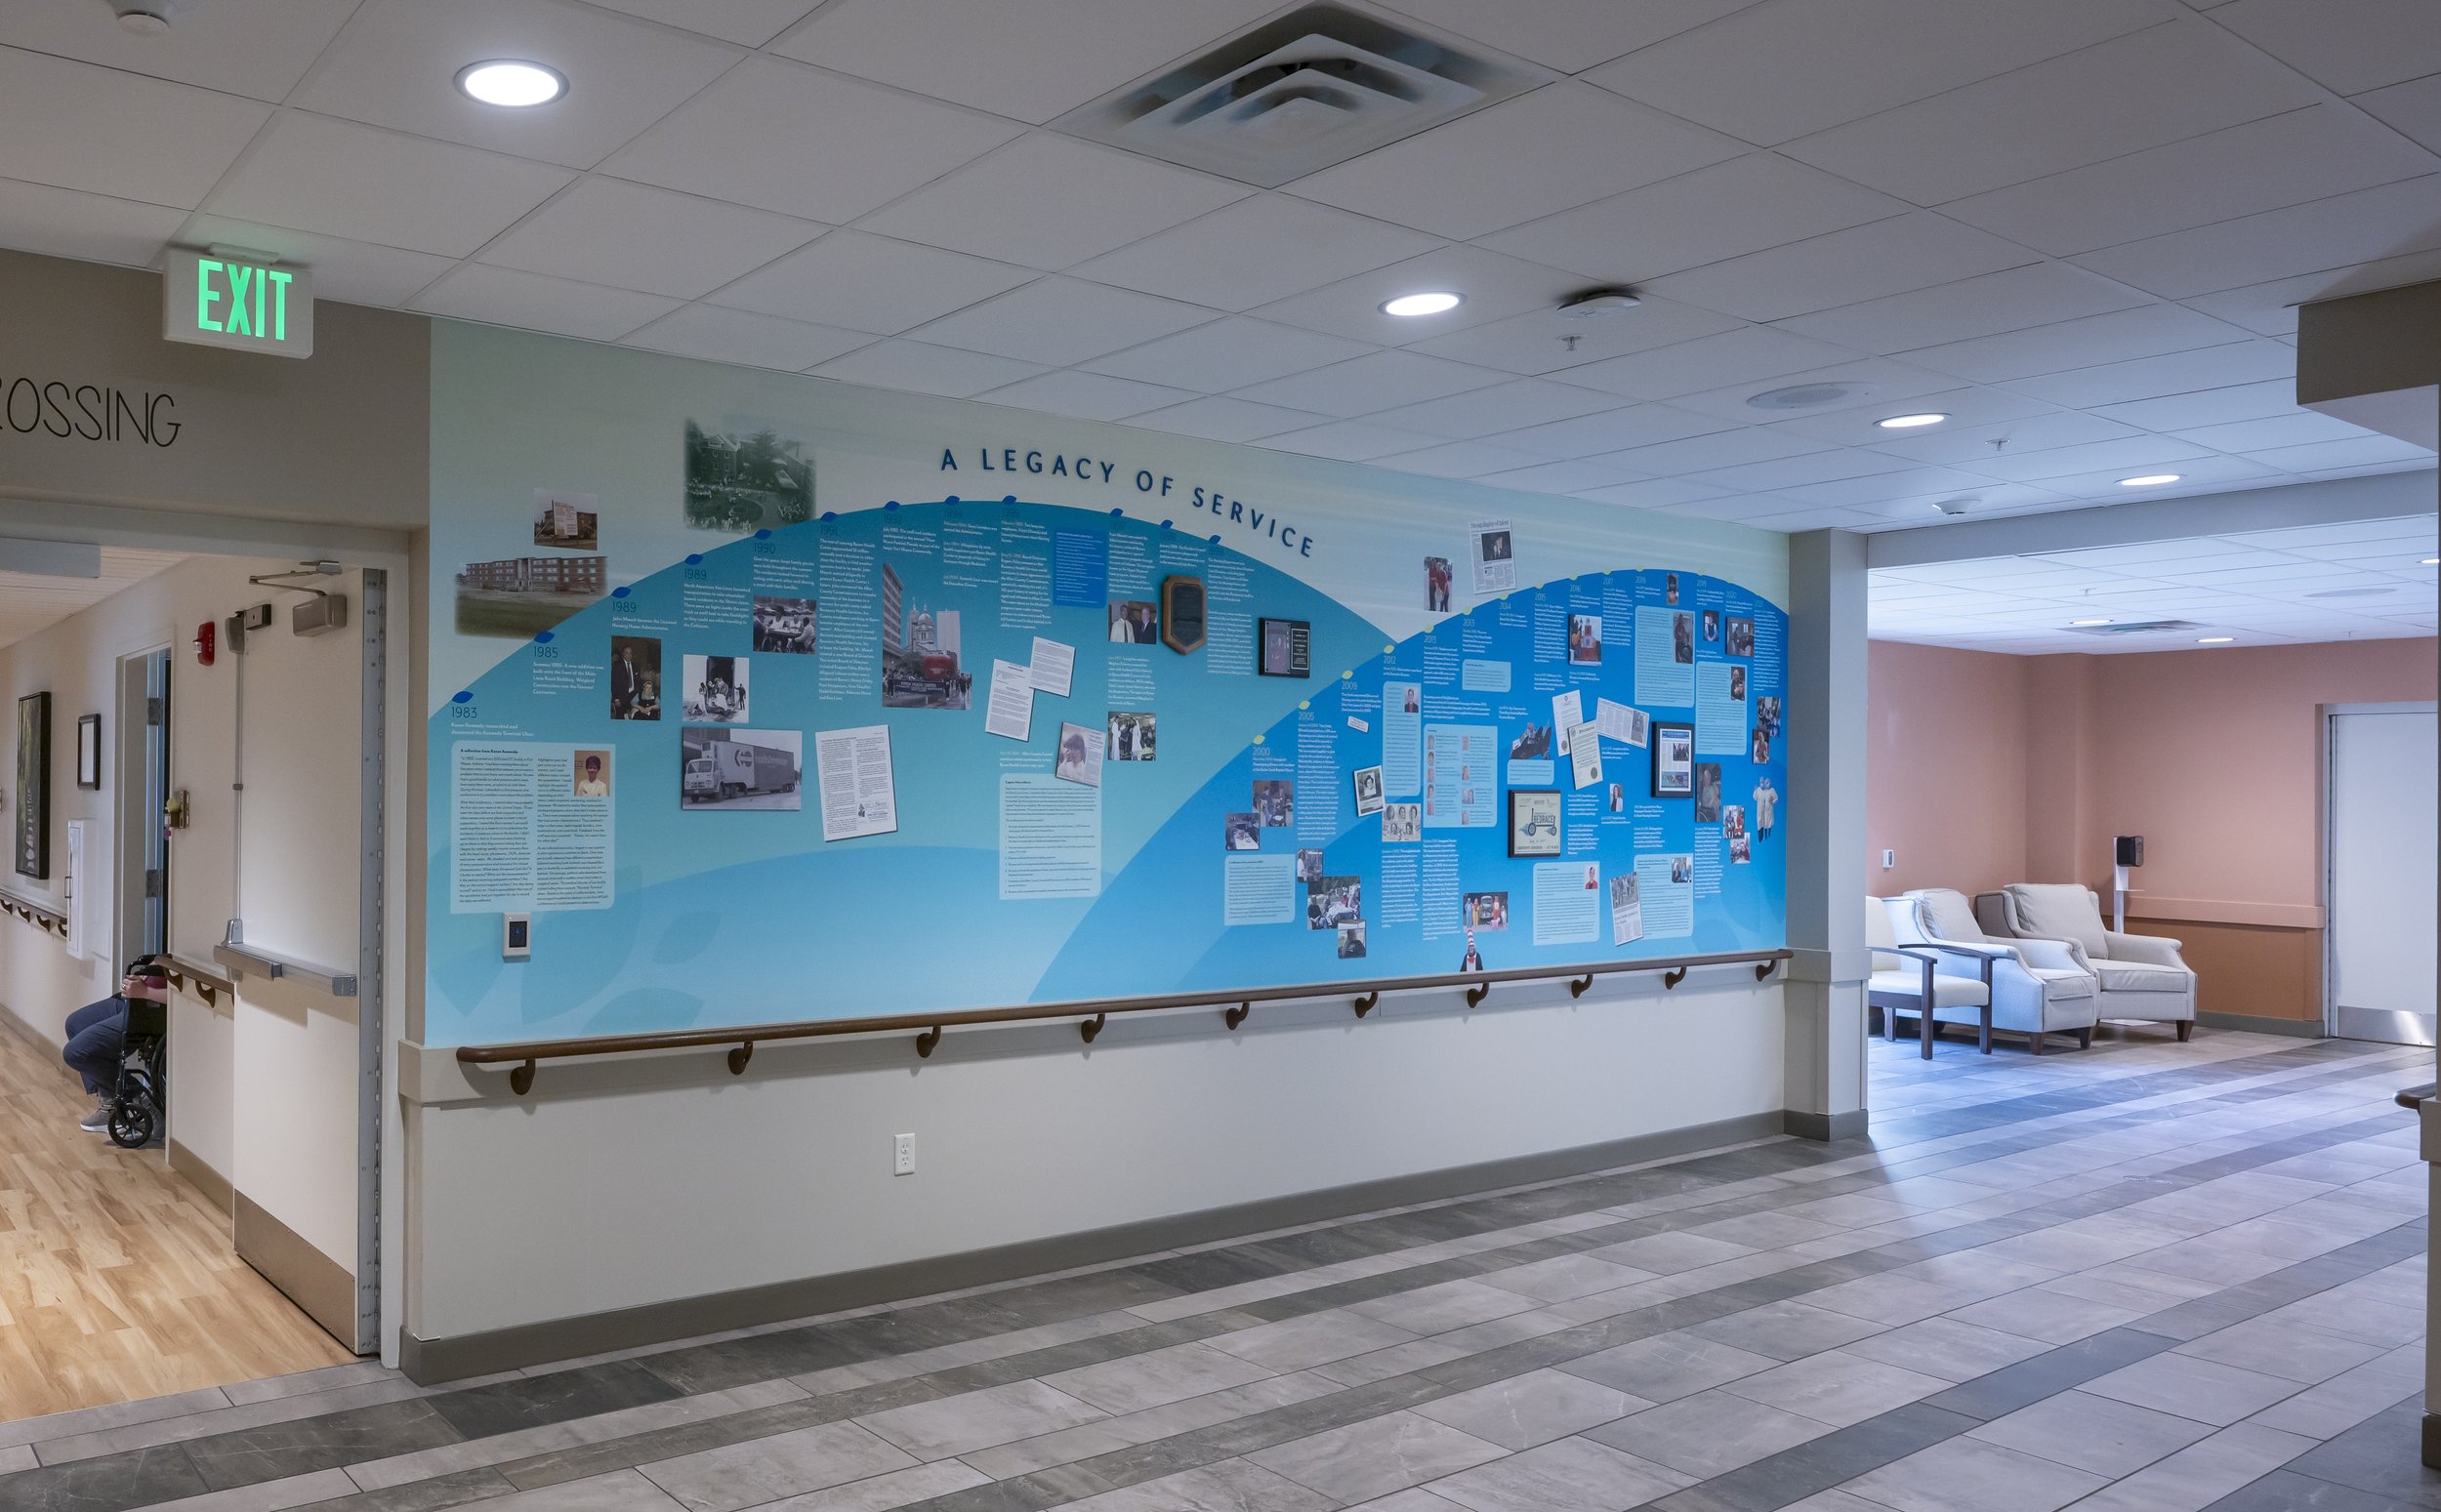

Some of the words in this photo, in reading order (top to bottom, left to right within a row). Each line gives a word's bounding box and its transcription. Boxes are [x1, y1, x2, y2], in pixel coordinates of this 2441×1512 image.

[198, 258, 293, 341] EXIT
[0, 377, 182, 447] OSSING
[941, 448, 958, 470] A
[982, 448, 1115, 483] LEGACY
[1137, 470, 1174, 497] OF
[1192, 486, 1314, 558] SERVICE
[754, 543, 776, 554] 1990
[684, 568, 707, 581] 1989
[612, 600, 637, 613] 1989
[533, 645, 559, 658] 1985
[1341, 680, 1357, 691] 2009
[451, 707, 477, 718] 1983
[1298, 712, 1314, 721] 2005
[1253, 747, 1270, 756] 2000
